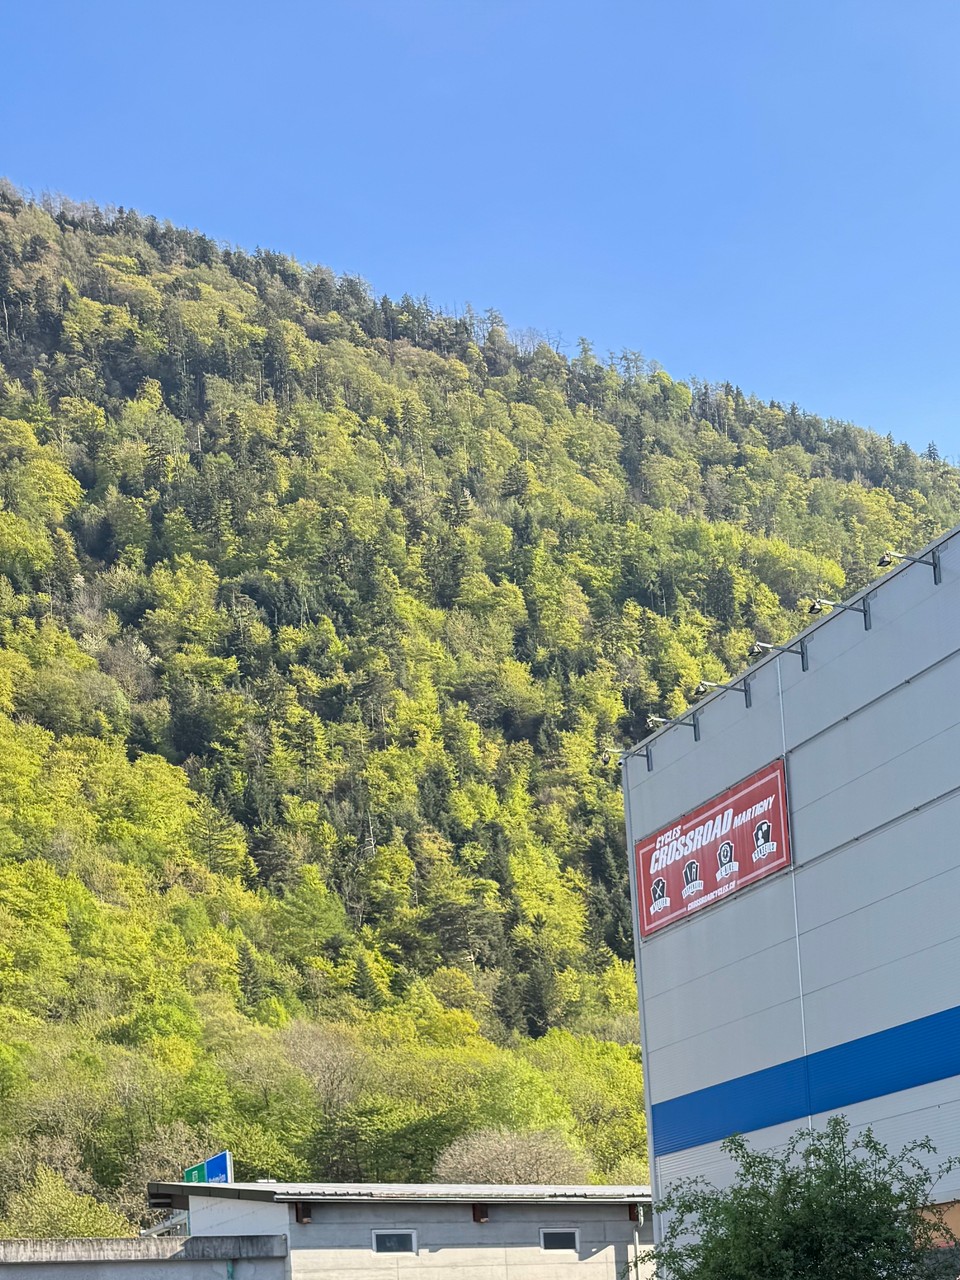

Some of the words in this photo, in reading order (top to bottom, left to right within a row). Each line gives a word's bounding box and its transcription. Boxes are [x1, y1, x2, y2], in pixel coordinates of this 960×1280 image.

[650, 808, 734, 874] CROSSROAD
[733, 794, 776, 829] MARTIGNY
[656, 825, 682, 849] CYCLES
